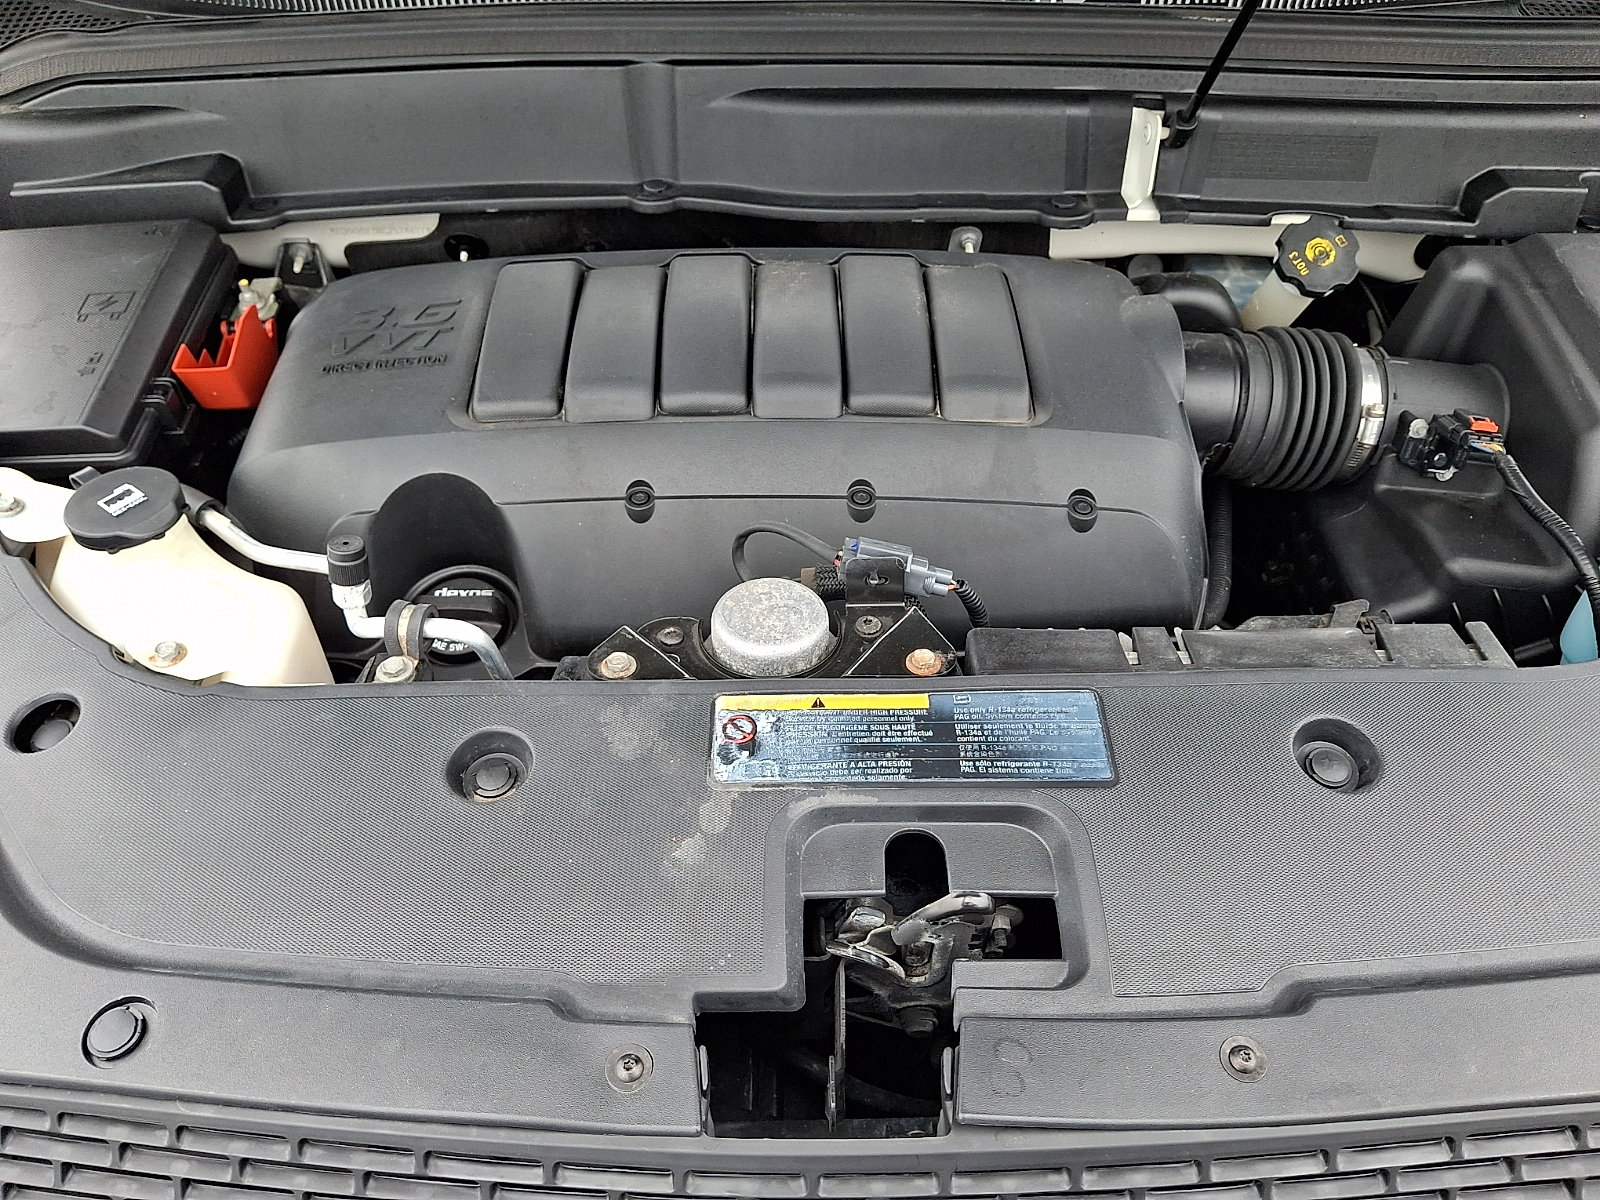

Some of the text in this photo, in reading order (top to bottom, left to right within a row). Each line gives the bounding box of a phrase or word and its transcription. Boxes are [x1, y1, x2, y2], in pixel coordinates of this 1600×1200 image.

[340, 299, 462, 335] 3.6
[331, 326, 454, 355] VVT
[322, 353, 449, 374] DIRECT INJECTION
[953, 707, 968, 715] Use
[970, 707, 986, 715] only
[899, 715, 916, 723] only.
[955, 722, 981, 730] Utiliser
[857, 760, 876, 768] ALTA
[877, 759, 912, 767] PRESIÓN
[959, 759, 974, 767] Use
[975, 759, 992, 767] sólo
[993, 759, 1041, 768] refrigerante
[829, 768, 849, 776] debe
[900, 767, 913, 775] por
[988, 766, 1019, 774] sistema
